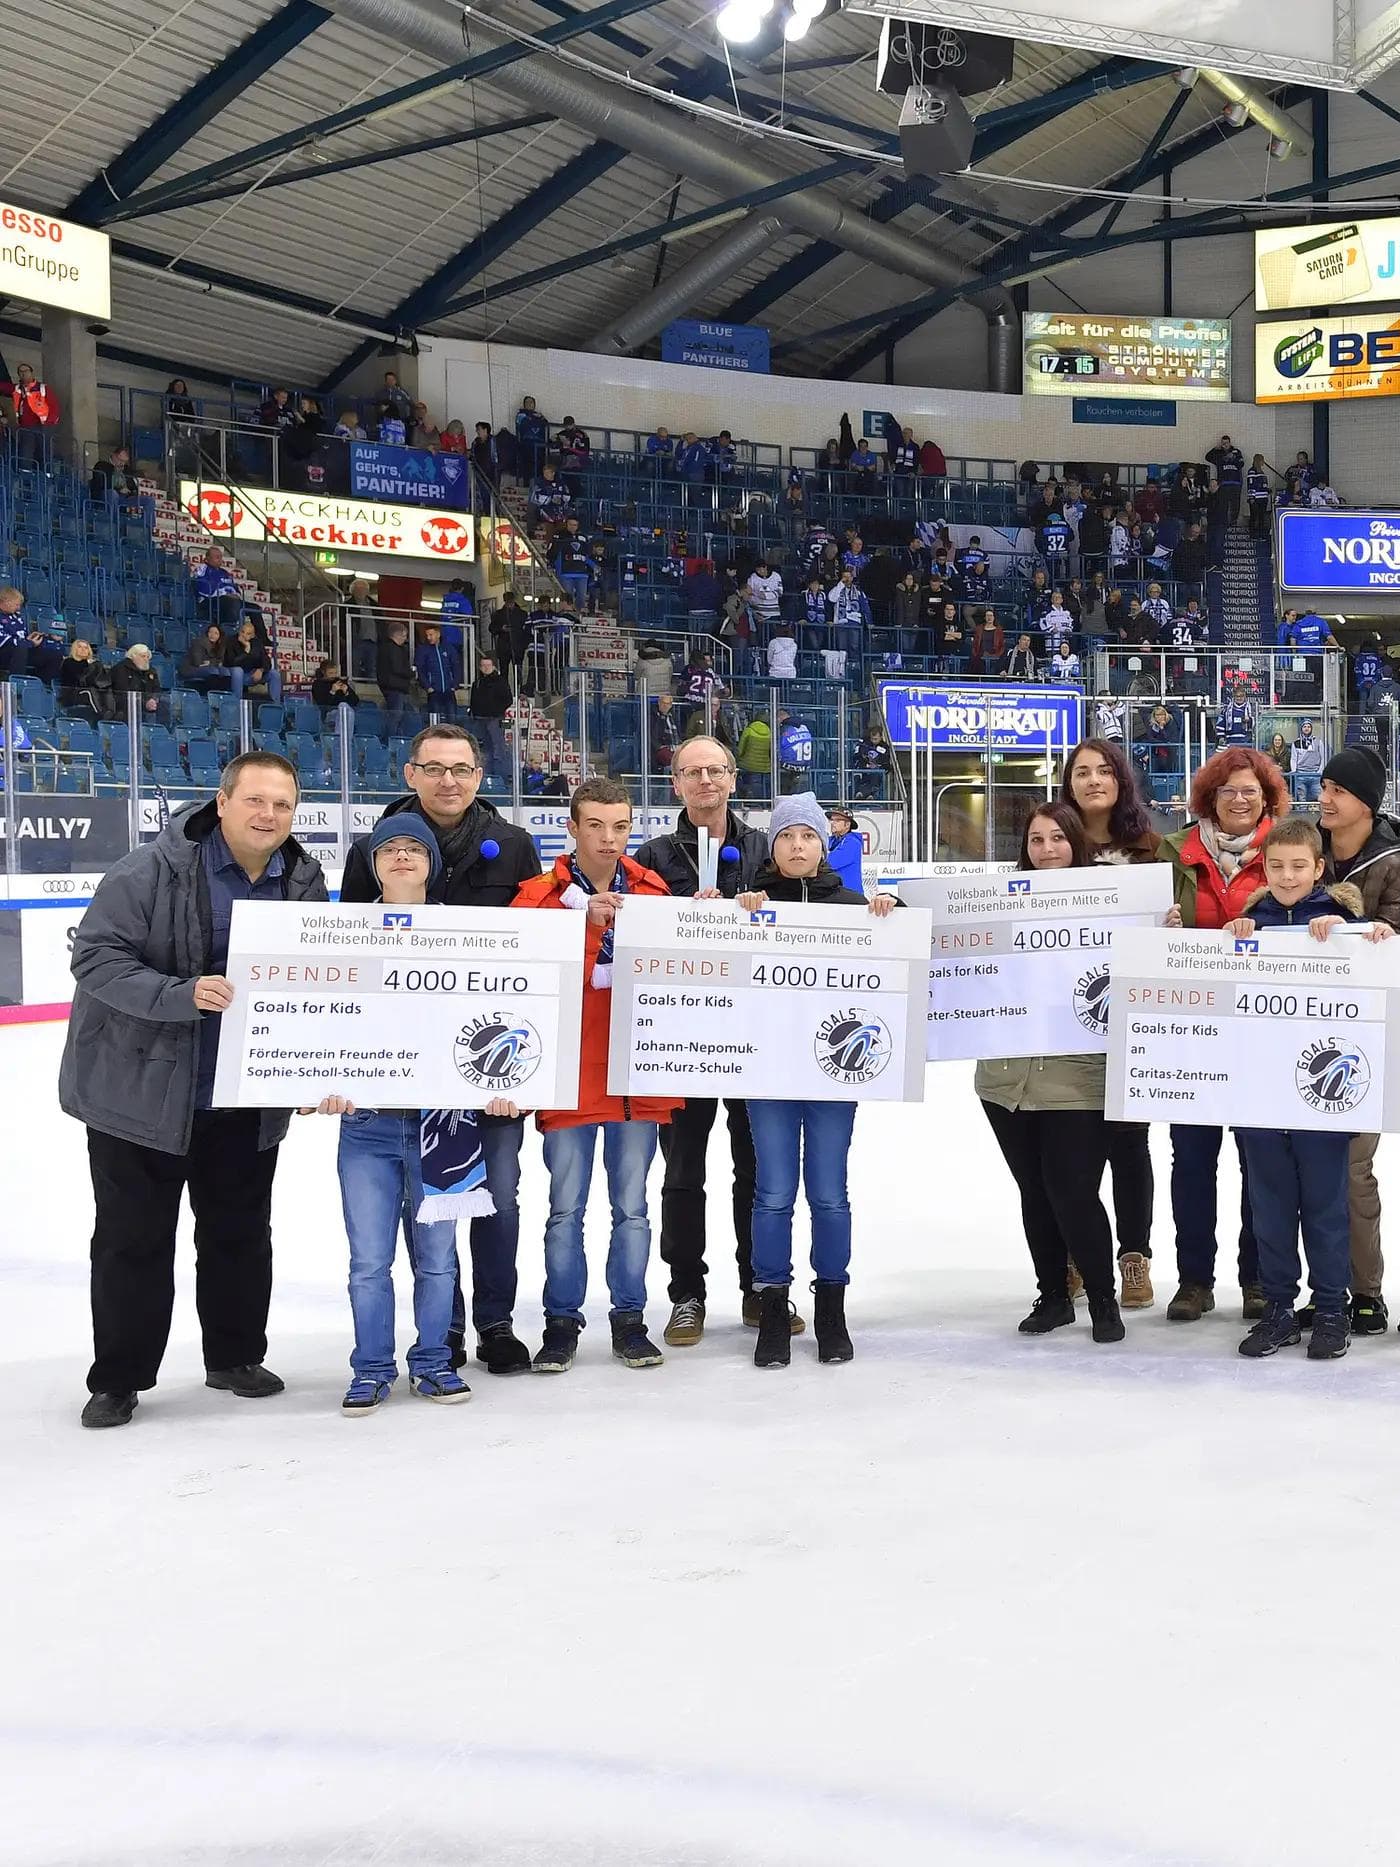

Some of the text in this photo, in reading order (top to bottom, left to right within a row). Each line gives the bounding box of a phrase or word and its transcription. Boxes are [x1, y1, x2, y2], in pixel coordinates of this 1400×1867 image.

[1307, 252, 1343, 273] SATURN
[1319, 263, 1344, 280] CARD
[700, 324, 733, 337] BLUE
[1032, 321, 1076, 336] Zeit
[1082, 324, 1114, 337] für
[1121, 325, 1151, 338] die
[1108, 345, 1226, 357] STRÖHMER
[1280, 331, 1317, 361] SYSTEM
[683, 351, 749, 369] PANTHERS
[1109, 356, 1226, 368] COMPUTER
[1296, 348, 1319, 371] LIFT
[1114, 367, 1220, 379] SYSTEME
[1278, 377, 1392, 391] ARBEITSBÜHNEN
[1087, 405, 1163, 417] Rauchen verboten
[871, 415, 883, 435] E
[355, 448, 379, 459] AUF
[356, 461, 401, 477] GEHT'S,
[356, 476, 446, 499] PANTHER!
[265, 498, 401, 526] BACKHAUS
[266, 516, 402, 549] Hackner
[949, 734, 1018, 744] INGOLSTADT
[882, 867, 905, 875] Audi
[948, 887, 997, 900] Volksbank
[948, 893, 1119, 915] Raiffeisenbank Bayern Mitte eG
[301, 916, 369, 930] Volksbank
[300, 932, 519, 949] Raiffeisenbank Bayern Mitte eG
[250, 965, 528, 993] SPENDE 4.000 Euro
[253, 1001, 361, 1015] Goals for Kids
[927, 1005, 1027, 1021] eter-Steuart-Haus
[252, 1024, 269, 1035] an
[456, 1012, 503, 1047] GOALS
[249, 1048, 419, 1060] Förderverein Freunde der
[635, 1040, 758, 1056] Johann-Nepomuk-
[247, 1066, 414, 1078] Sophie-Scholl-Schule e.V.
[635, 1061, 742, 1074] von-Kurz-Schule
[1130, 1067, 1228, 1082] Caritas-Zentrum
[458, 1062, 522, 1090] FOR KIDS
[1130, 1087, 1195, 1100] St. Vinzenz
